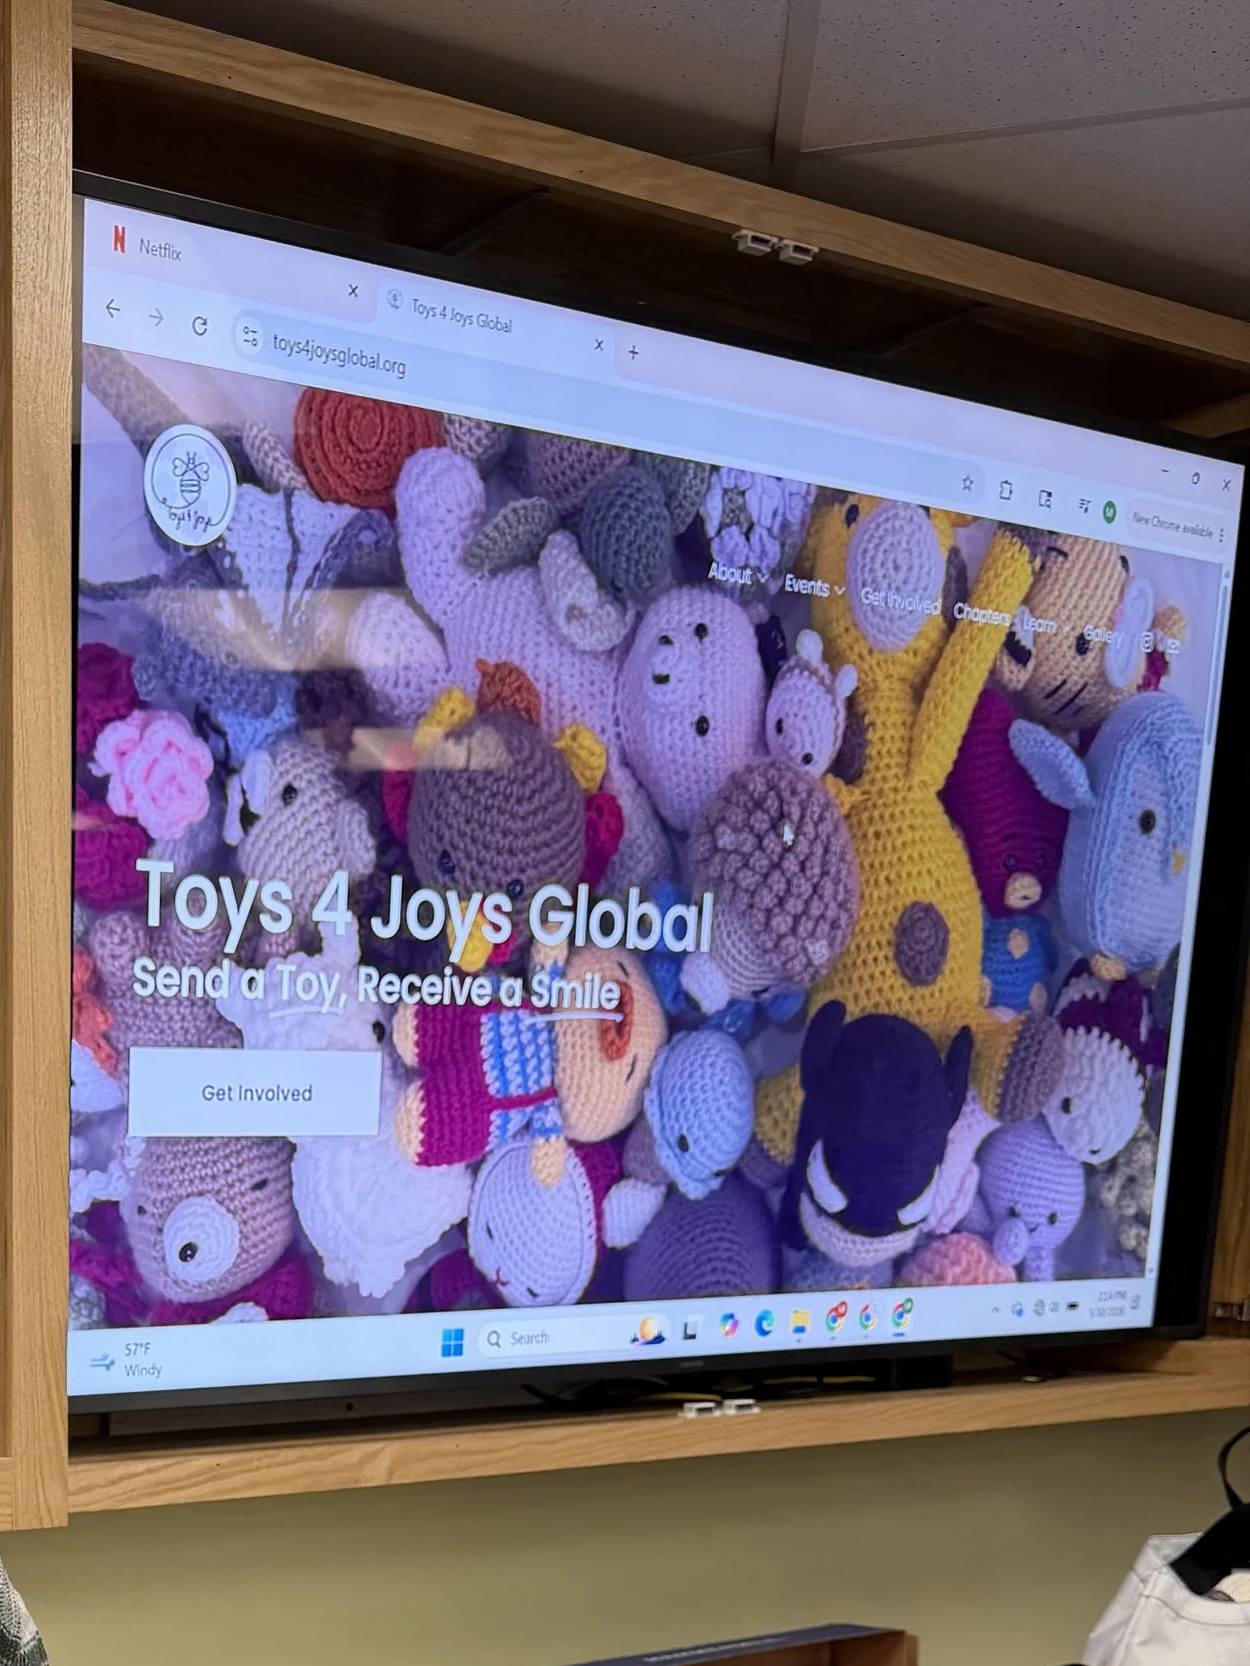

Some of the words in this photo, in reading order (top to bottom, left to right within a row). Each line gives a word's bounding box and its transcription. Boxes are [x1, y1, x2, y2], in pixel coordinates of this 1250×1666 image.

[139, 238, 182, 261] Netflix
[412, 298, 437, 320] Toys
[440, 305, 447, 320] 4
[450, 308, 474, 328] Joys
[476, 313, 512, 334] Global
[273, 334, 406, 380] toys4joysglobal.org
[1151, 515, 1180, 533] Chrome
[1182, 523, 1214, 539] available
[708, 561, 752, 585] About
[785, 573, 830, 598] Events
[861, 587, 885, 607] Get
[888, 591, 942, 616] Involved
[953, 602, 1013, 627] Chapters
[1023, 615, 1056, 633] Learn
[1083, 624, 1124, 648] Gallery
[135, 858, 295, 954] Toys
[311, 869, 351, 936] 4
[371, 874, 513, 963] Joys
[529, 883, 714, 953] Global
[133, 956, 229, 1000] Send
[241, 966, 264, 1000] a
[276, 963, 347, 1013] Toy,
[357, 966, 492, 1006] Receive
[499, 977, 522, 1007] a
[530, 970, 622, 1010] Smile
[201, 1084, 233, 1102] Get
[238, 1084, 313, 1102] Involved
[124, 1342, 152, 1357] 57°F
[510, 1330, 550, 1346] Search
[124, 1362, 163, 1379] Windy
